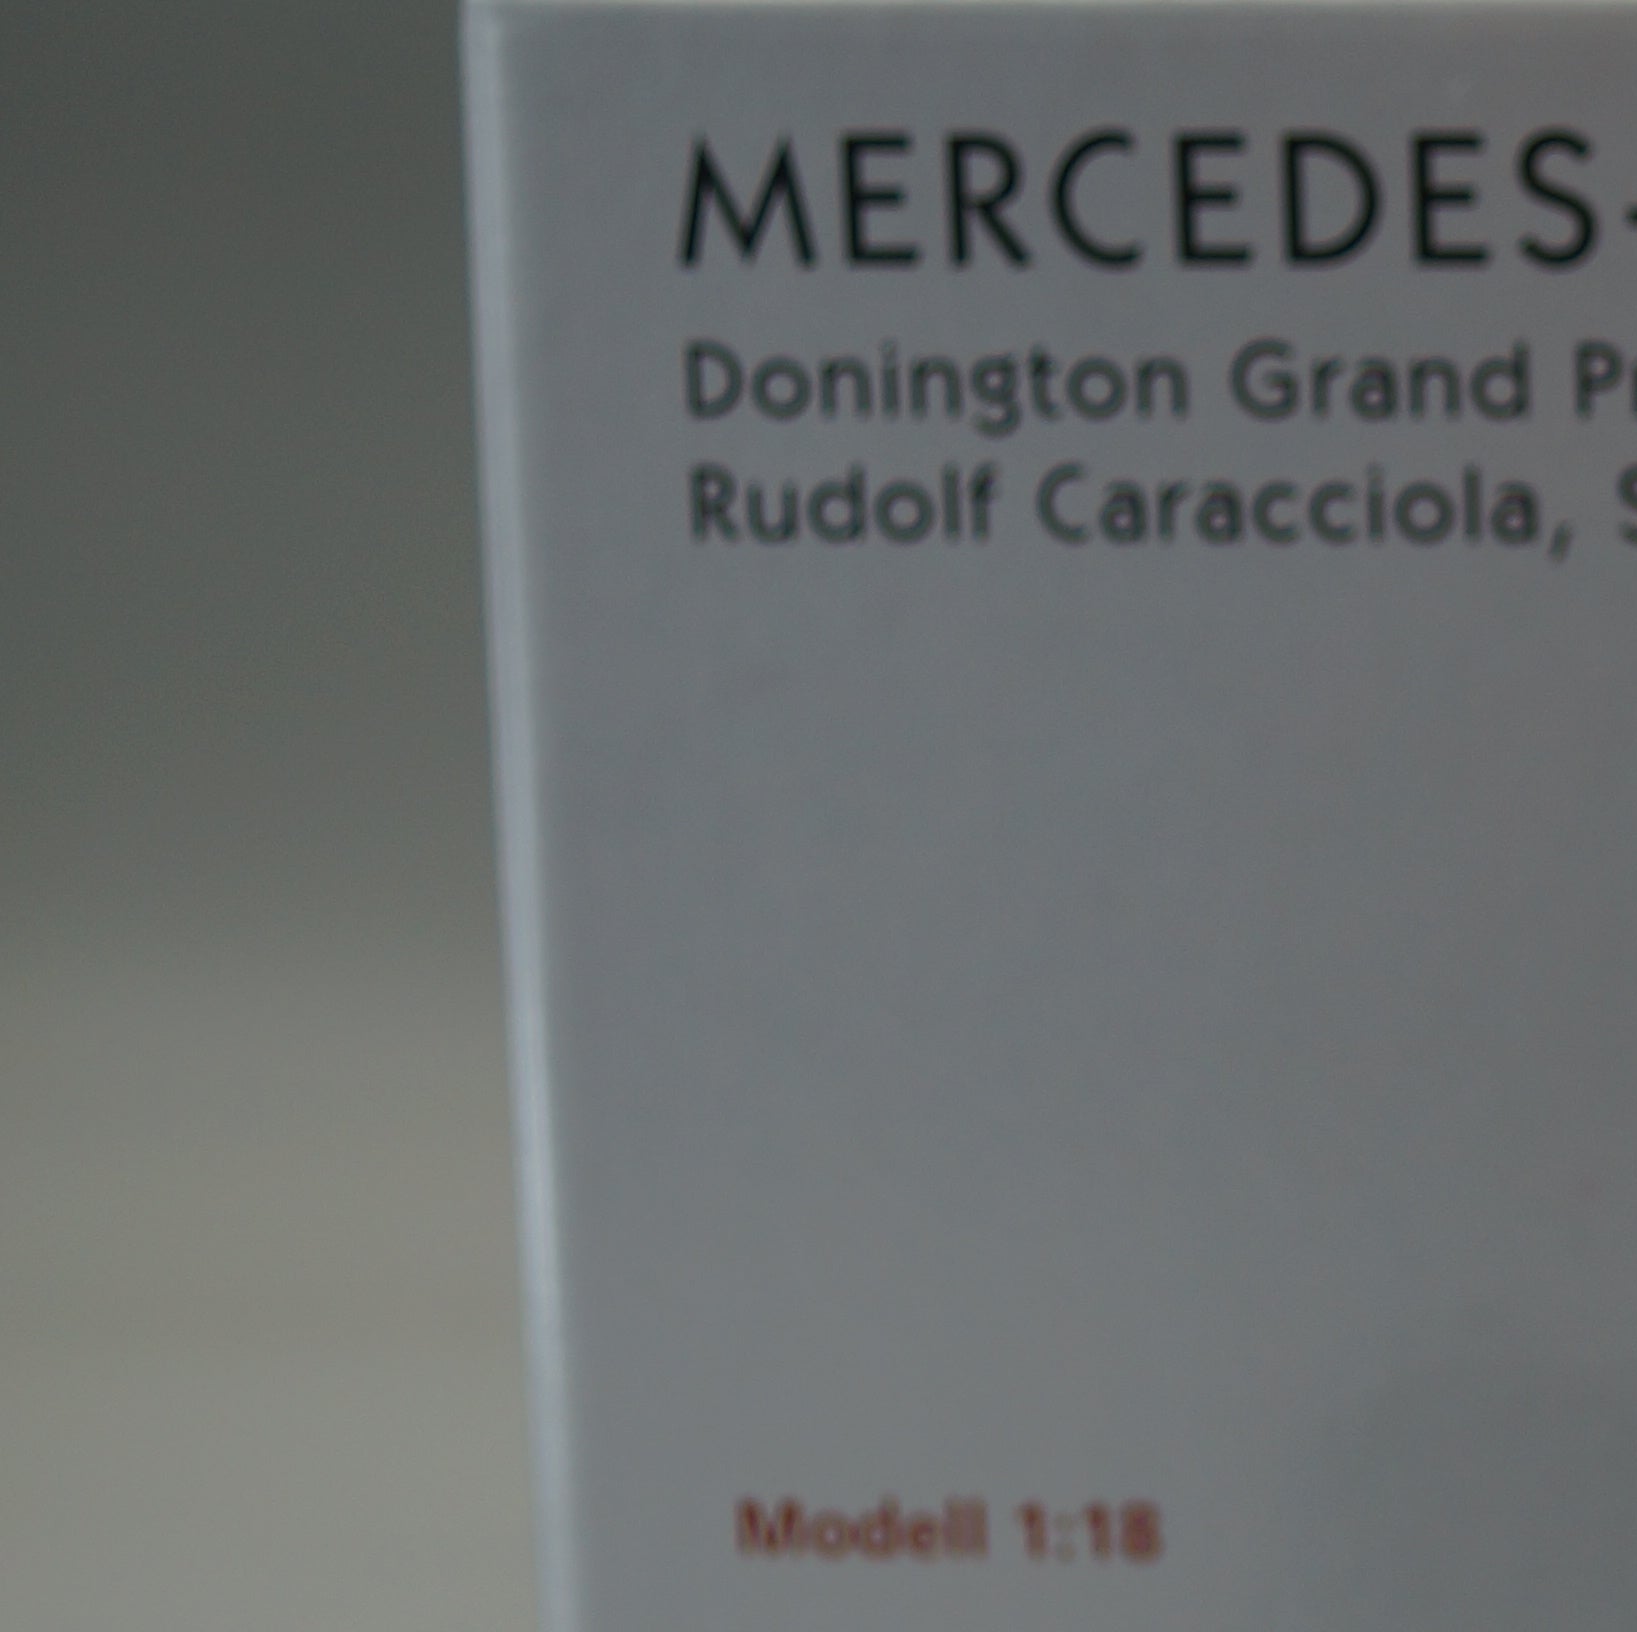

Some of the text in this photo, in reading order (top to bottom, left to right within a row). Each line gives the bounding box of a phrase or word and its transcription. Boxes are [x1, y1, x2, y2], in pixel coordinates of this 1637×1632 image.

[682, 336, 1192, 440] Donington
[1227, 335, 1533, 424] Grand
[687, 459, 999, 547] Rudolf
[1034, 460, 1575, 564] Caracciola,
[734, 1496, 1166, 1566] Modell 1:18
